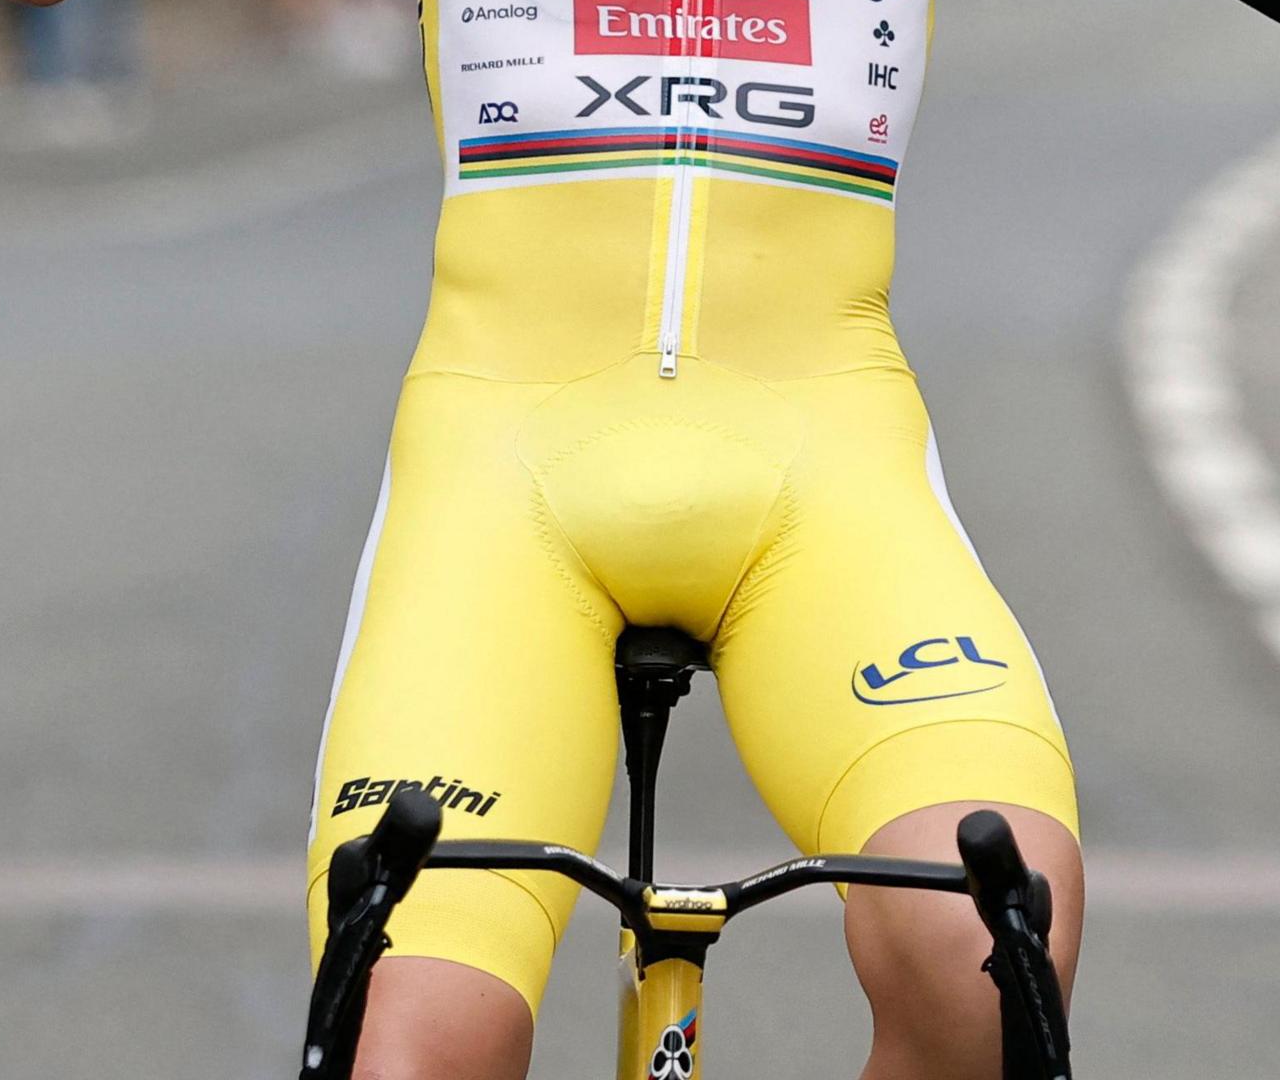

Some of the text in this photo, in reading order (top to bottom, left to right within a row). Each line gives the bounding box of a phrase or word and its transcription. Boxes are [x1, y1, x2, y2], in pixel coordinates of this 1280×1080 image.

[475, 3, 539, 22] Analog
[595, 4, 788, 45] Emirates
[460, 55, 545, 72] RICHARD MILLE
[867, 62, 900, 91] IHC
[477, 100, 520, 125] ADQ
[574, 75, 816, 129] XRG
[860, 636, 1009, 690] LCL
[788, 858, 826, 872] MILLE
